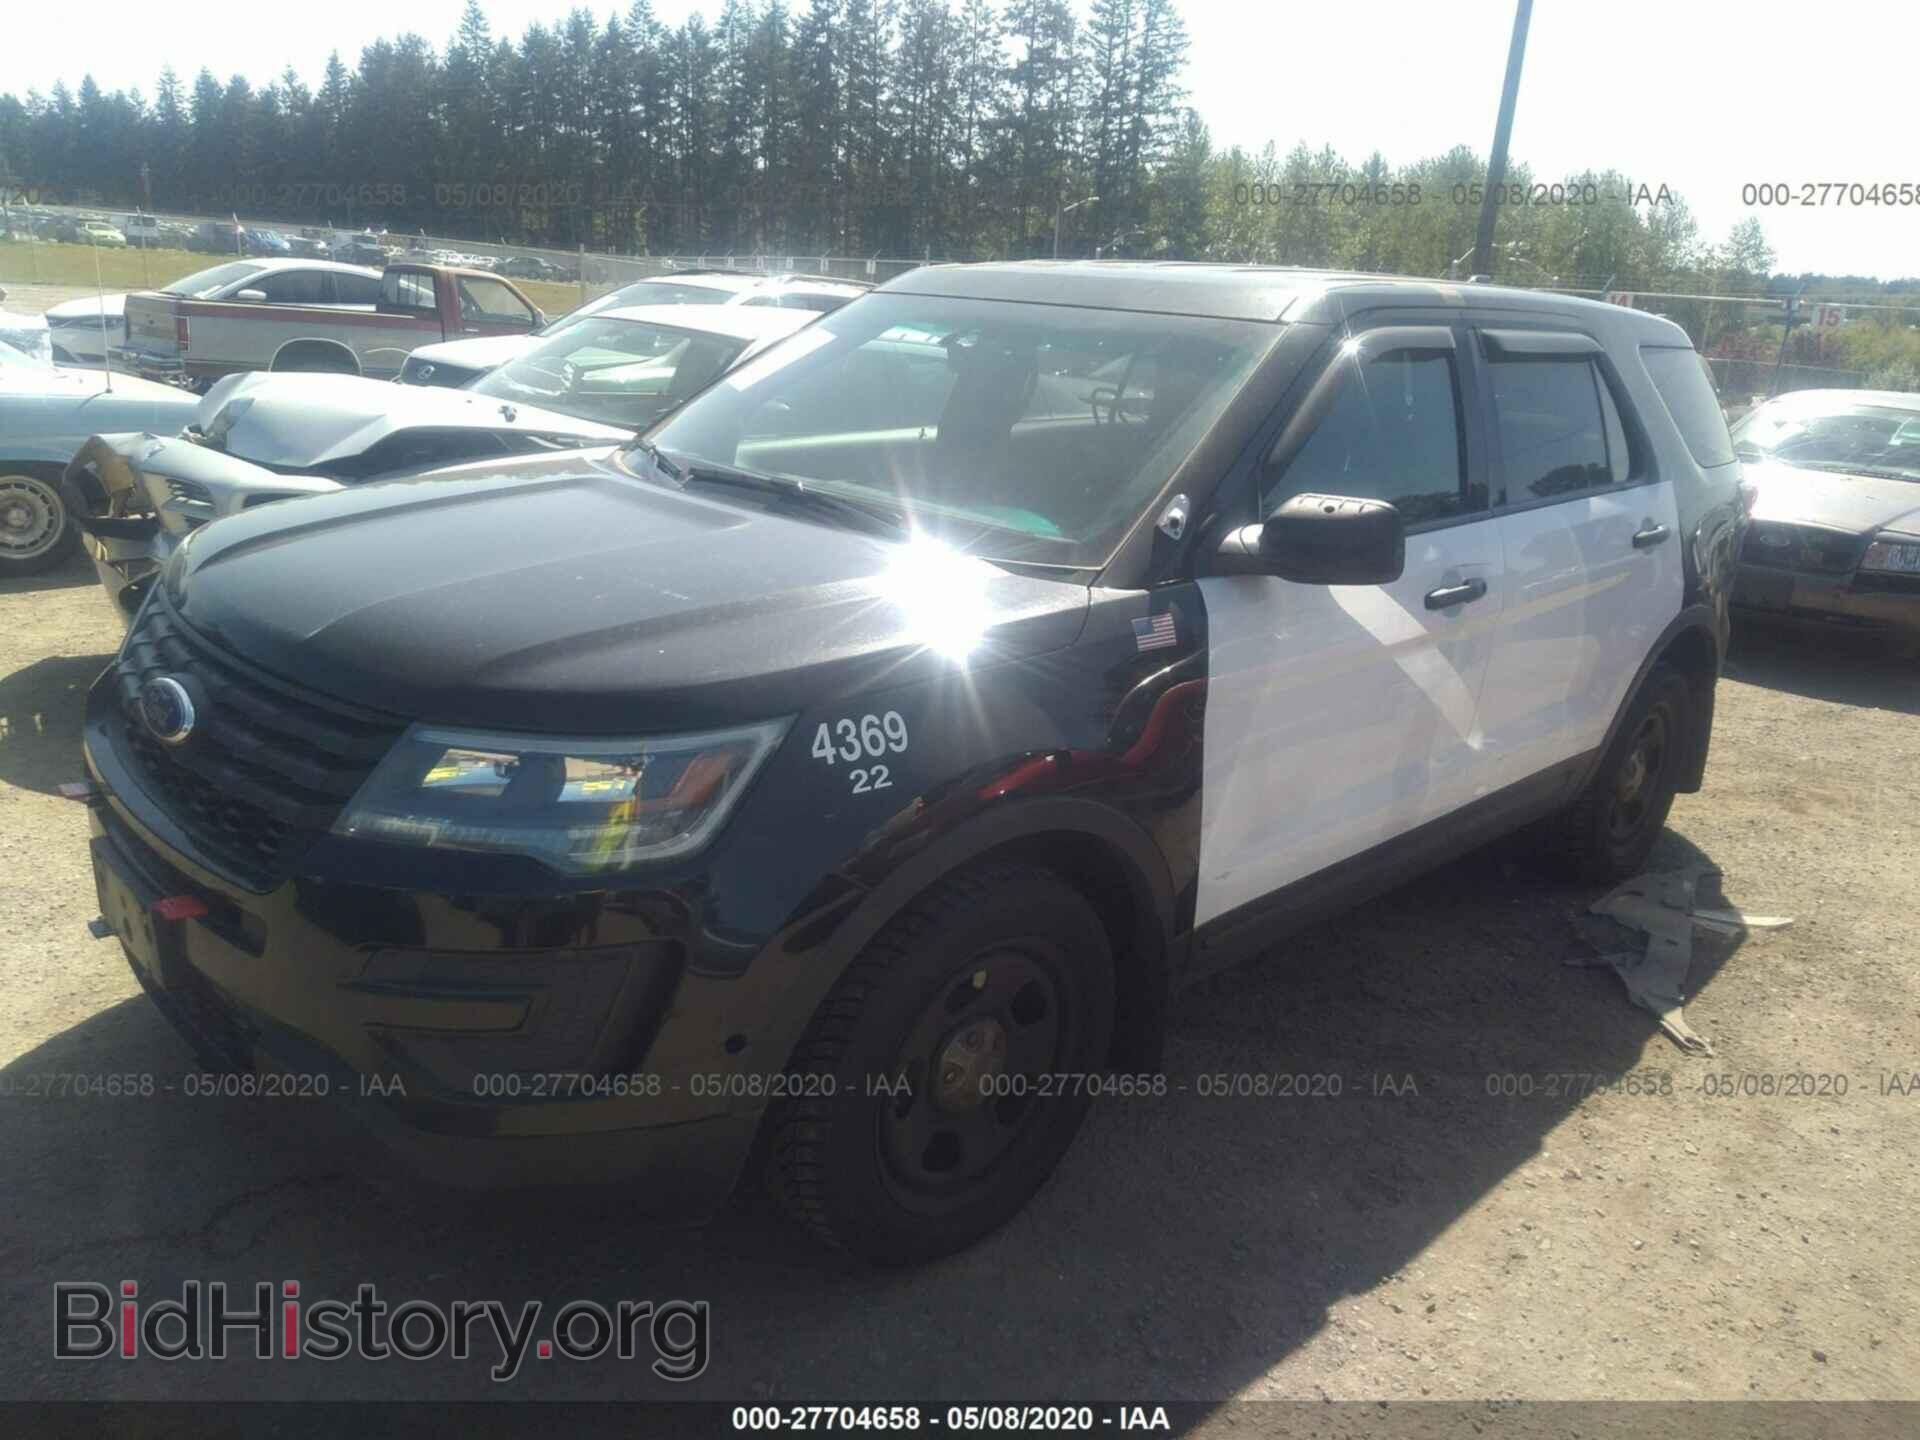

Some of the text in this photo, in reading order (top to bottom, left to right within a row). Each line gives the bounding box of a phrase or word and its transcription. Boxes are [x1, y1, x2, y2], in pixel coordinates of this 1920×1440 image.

[1818, 304, 1841, 328] 15
[811, 710, 909, 765] 4369
[849, 764, 894, 794] 22
